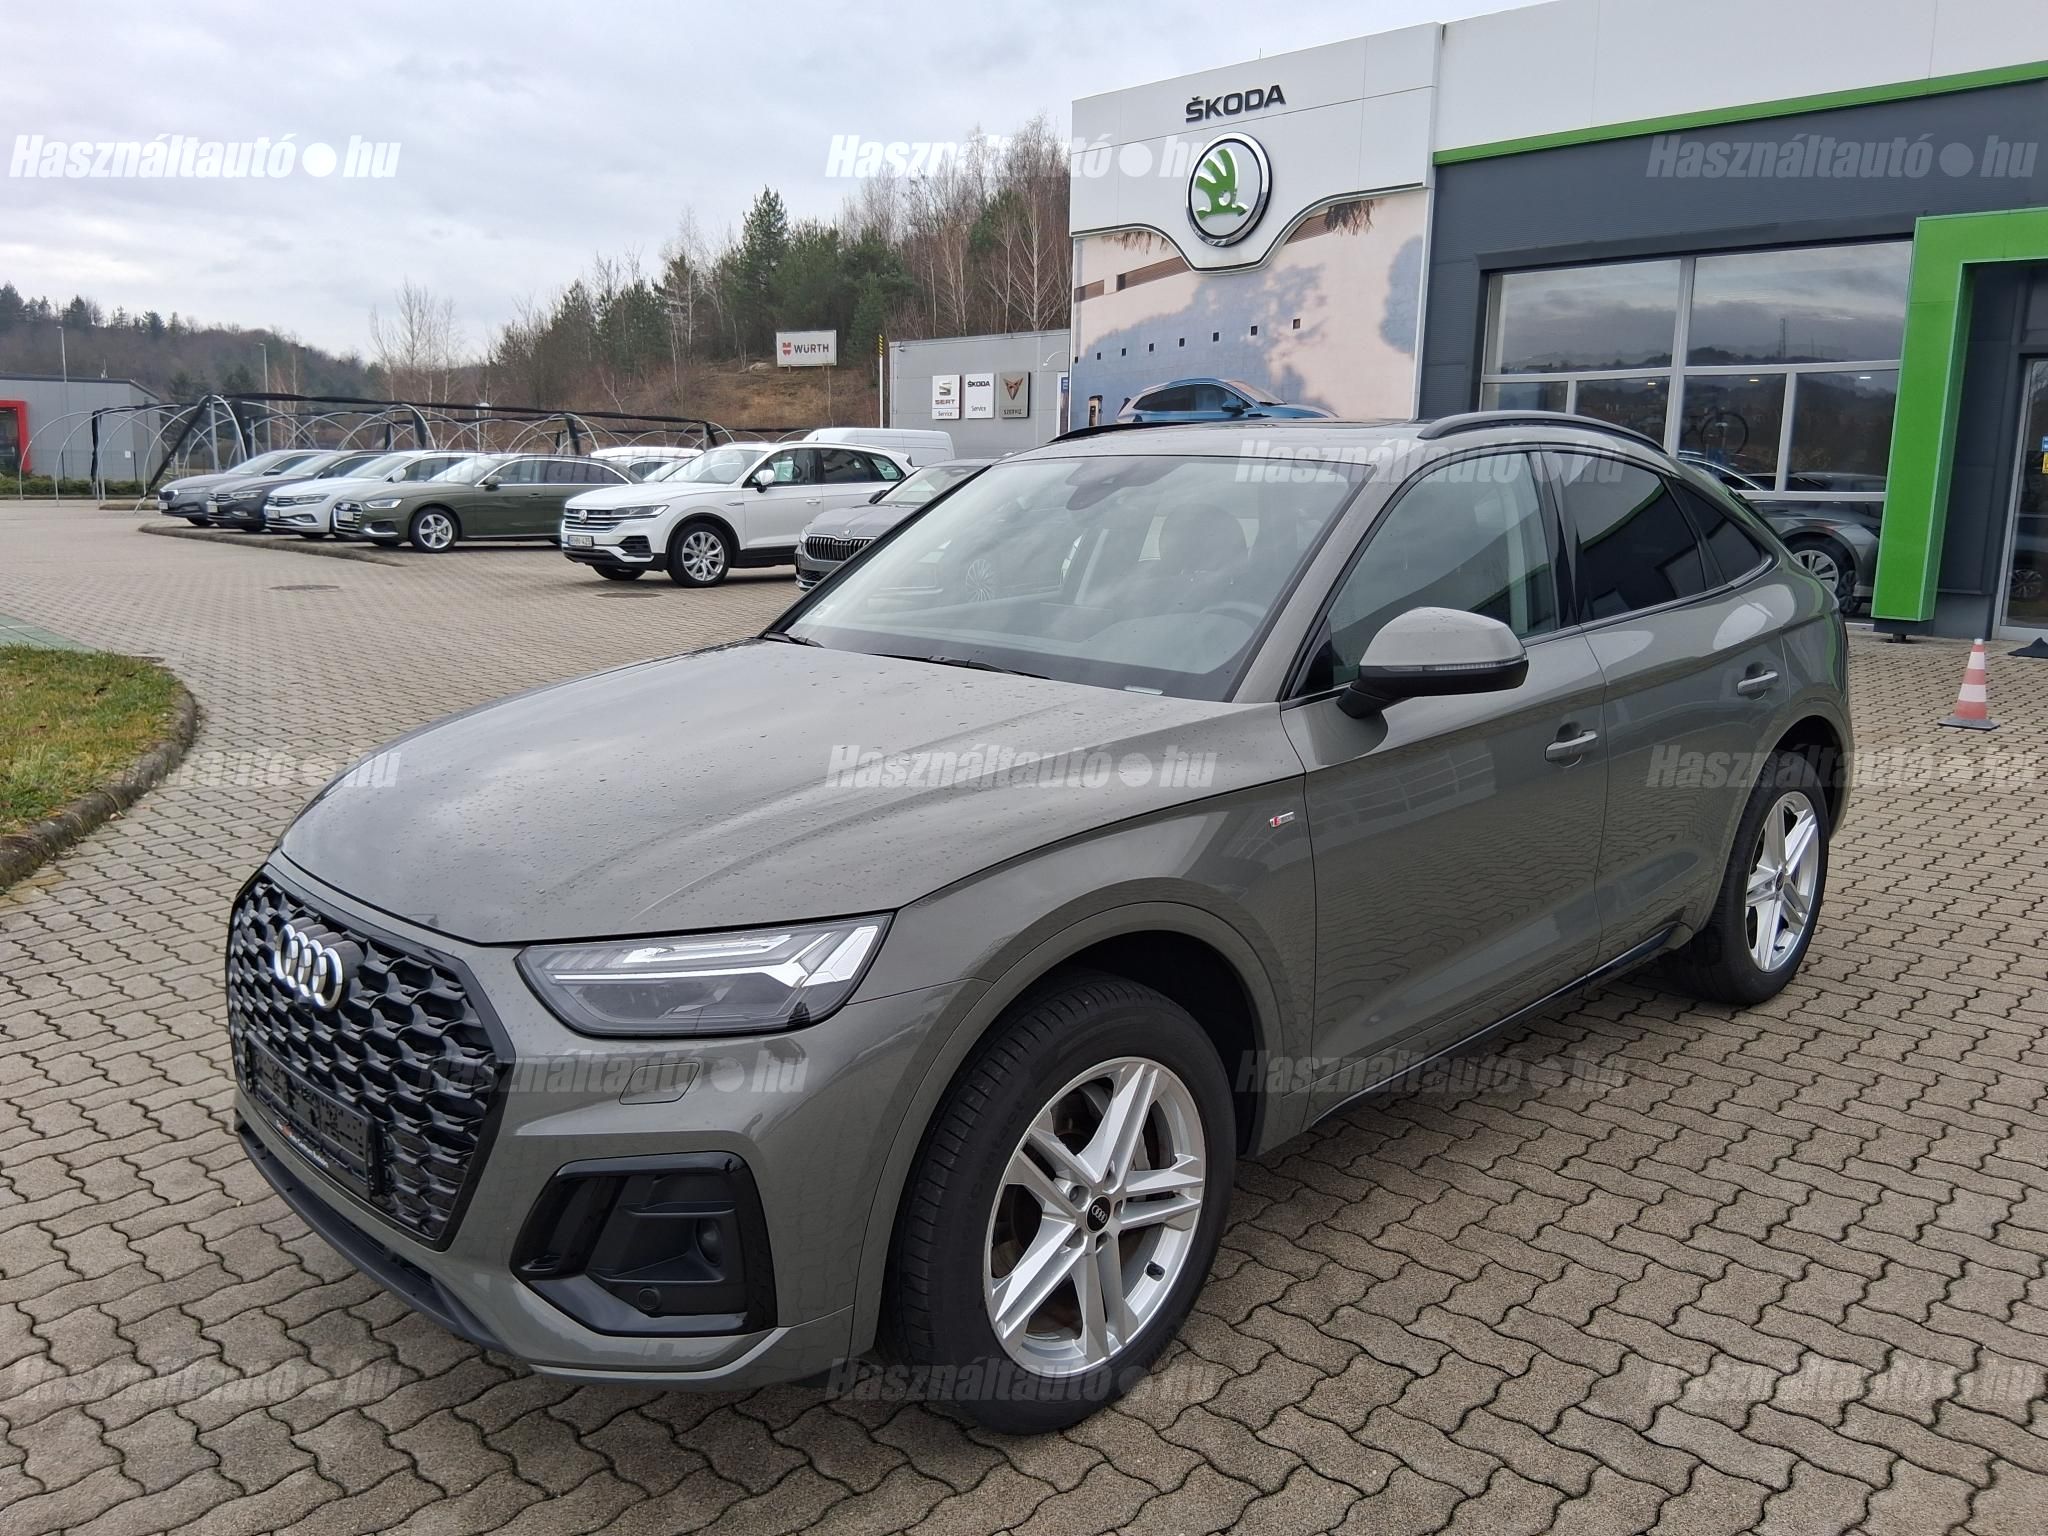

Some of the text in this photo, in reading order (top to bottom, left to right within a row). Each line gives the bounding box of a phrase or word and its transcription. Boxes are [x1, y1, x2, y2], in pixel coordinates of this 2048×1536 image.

[1185, 85, 1286, 123] ŠKODA
[794, 343, 829, 354] WÜRTH
[967, 380, 991, 388] ŠKODA
[934, 398, 956, 406] SEAT
